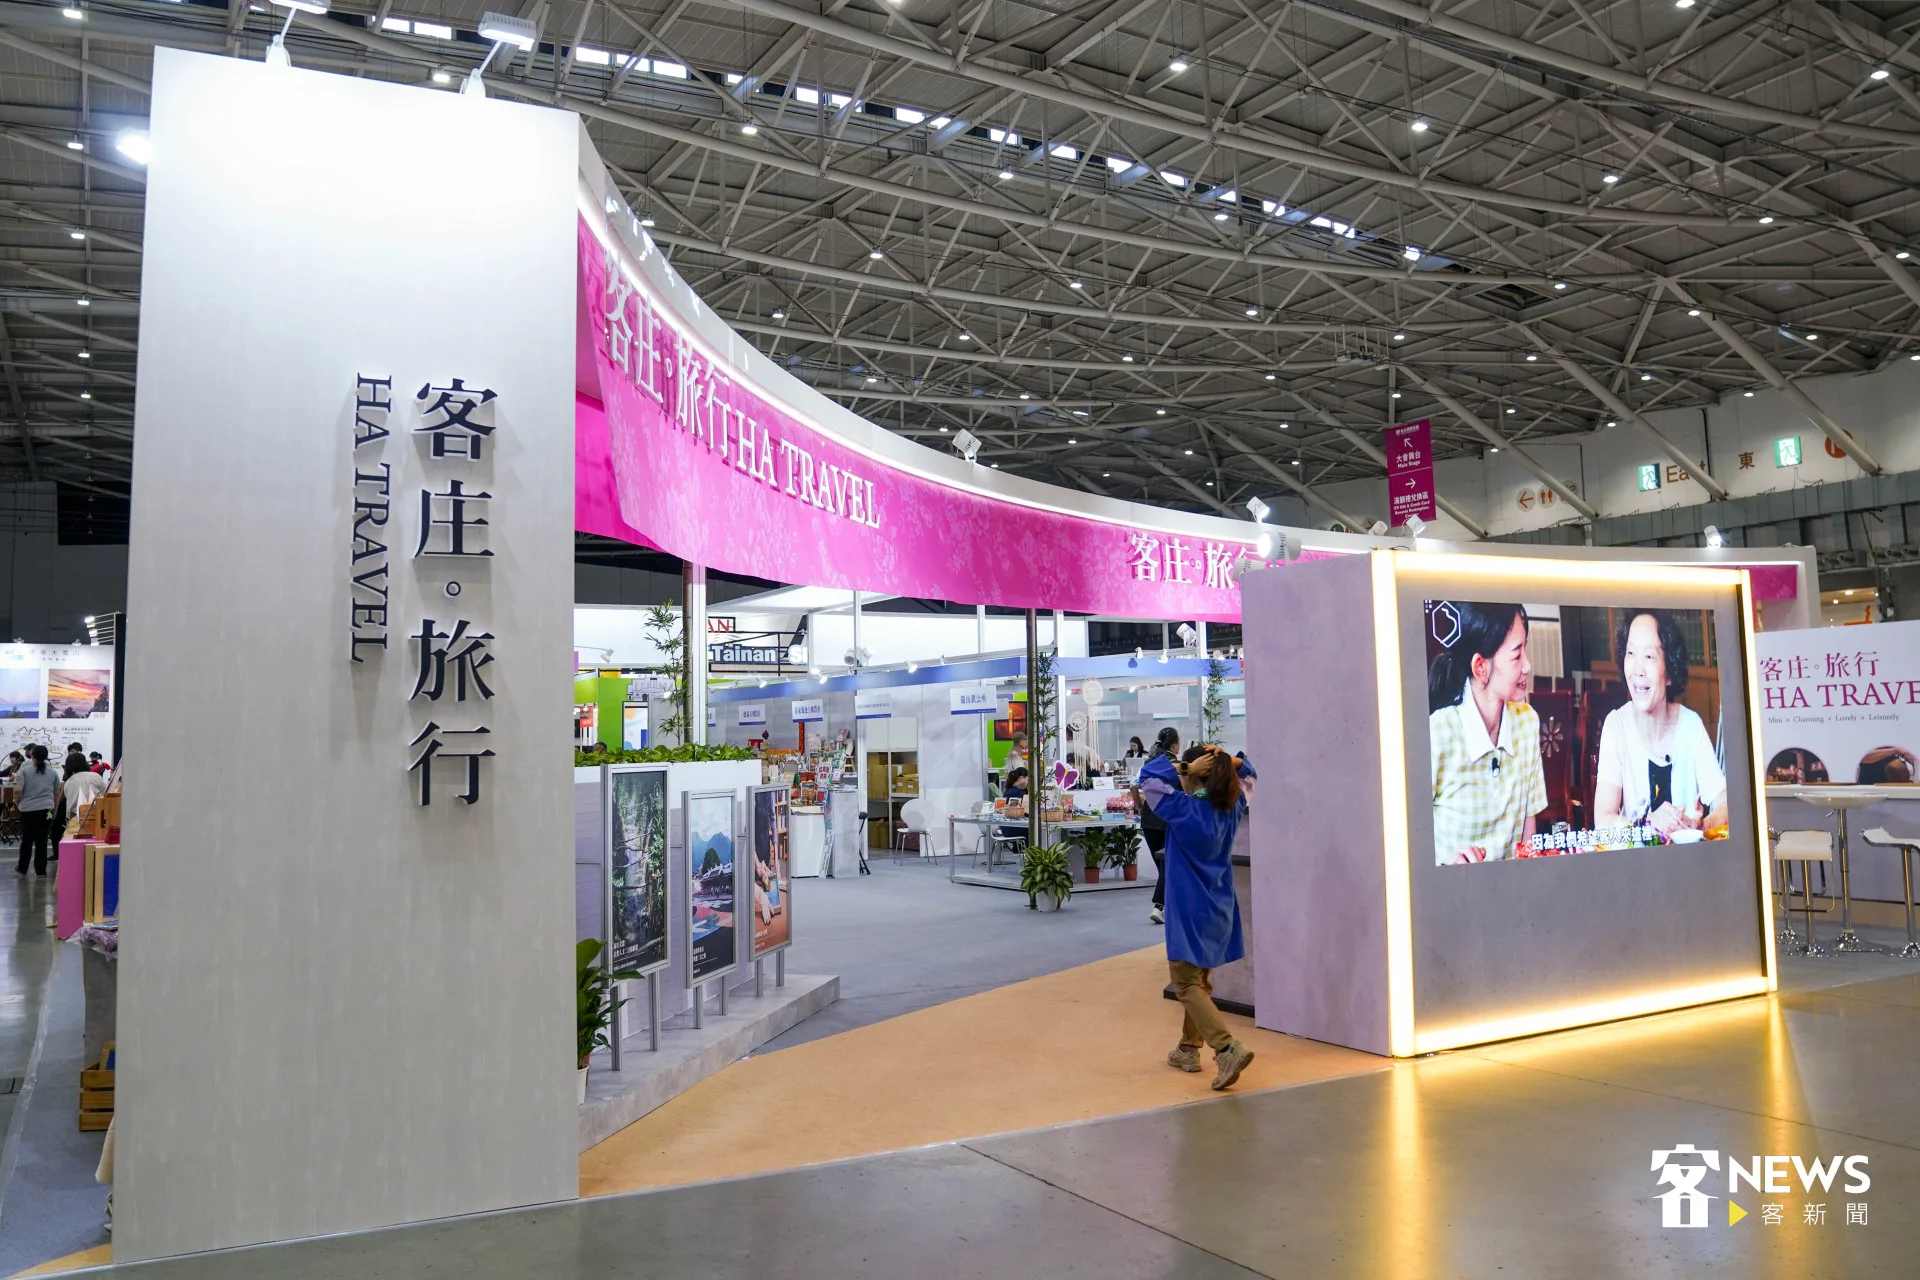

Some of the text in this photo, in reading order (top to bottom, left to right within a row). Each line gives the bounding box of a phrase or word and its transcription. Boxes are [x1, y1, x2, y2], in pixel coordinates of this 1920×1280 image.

[735, 409, 880, 529] HA TRAVEL
[1666, 460, 1706, 483] Eat
[1738, 451, 1755, 470] 東
[351, 372, 392, 663] HA TRAVEL
[712, 645, 776, 662] Tainan
[1764, 680, 1920, 709] HA TRAVE
[1768, 716, 1783, 724] Mini
[1793, 715, 1825, 723] Charming
[1868, 713, 1900, 721] Leisurely
